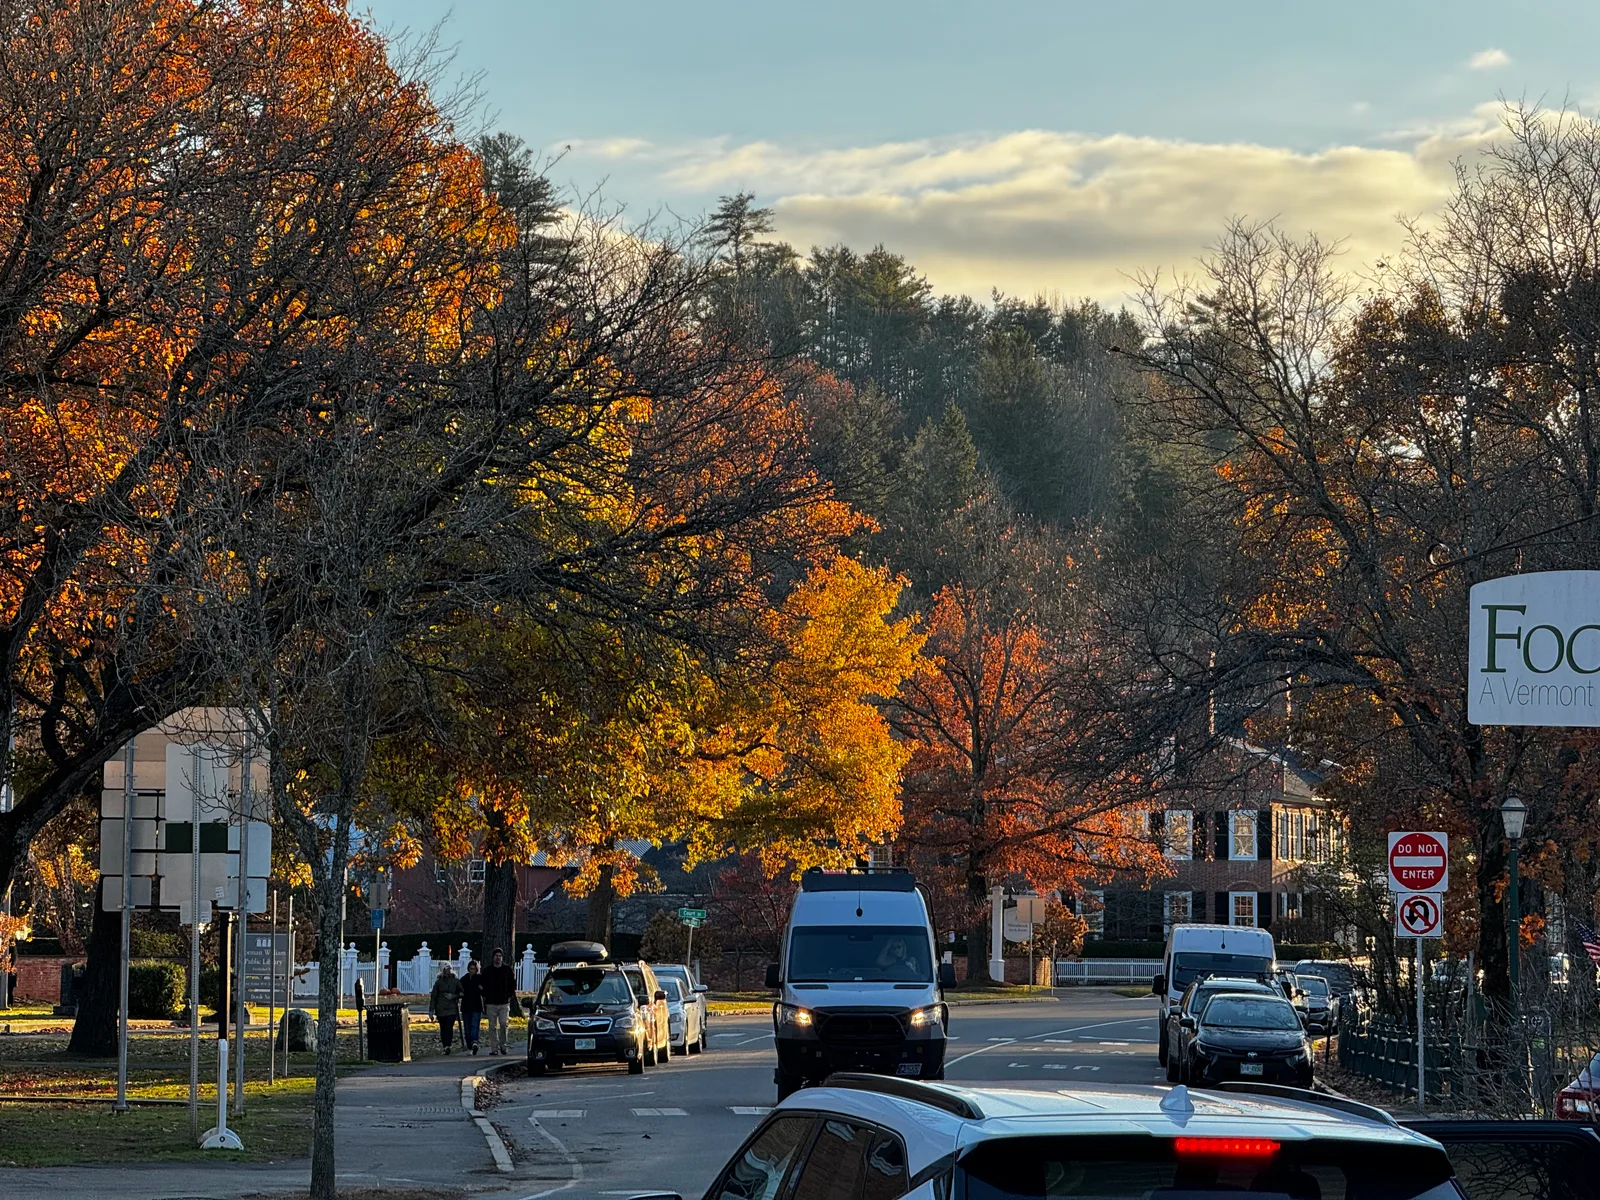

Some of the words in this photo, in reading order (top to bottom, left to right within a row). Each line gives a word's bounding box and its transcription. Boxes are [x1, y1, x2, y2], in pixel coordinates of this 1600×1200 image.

[1479, 676, 1496, 705] A
[1502, 677, 1594, 707] Vermont
[1398, 844, 1412, 854] DO
[1418, 844, 1439, 854] NOT
[1402, 870, 1435, 879] ENTER
